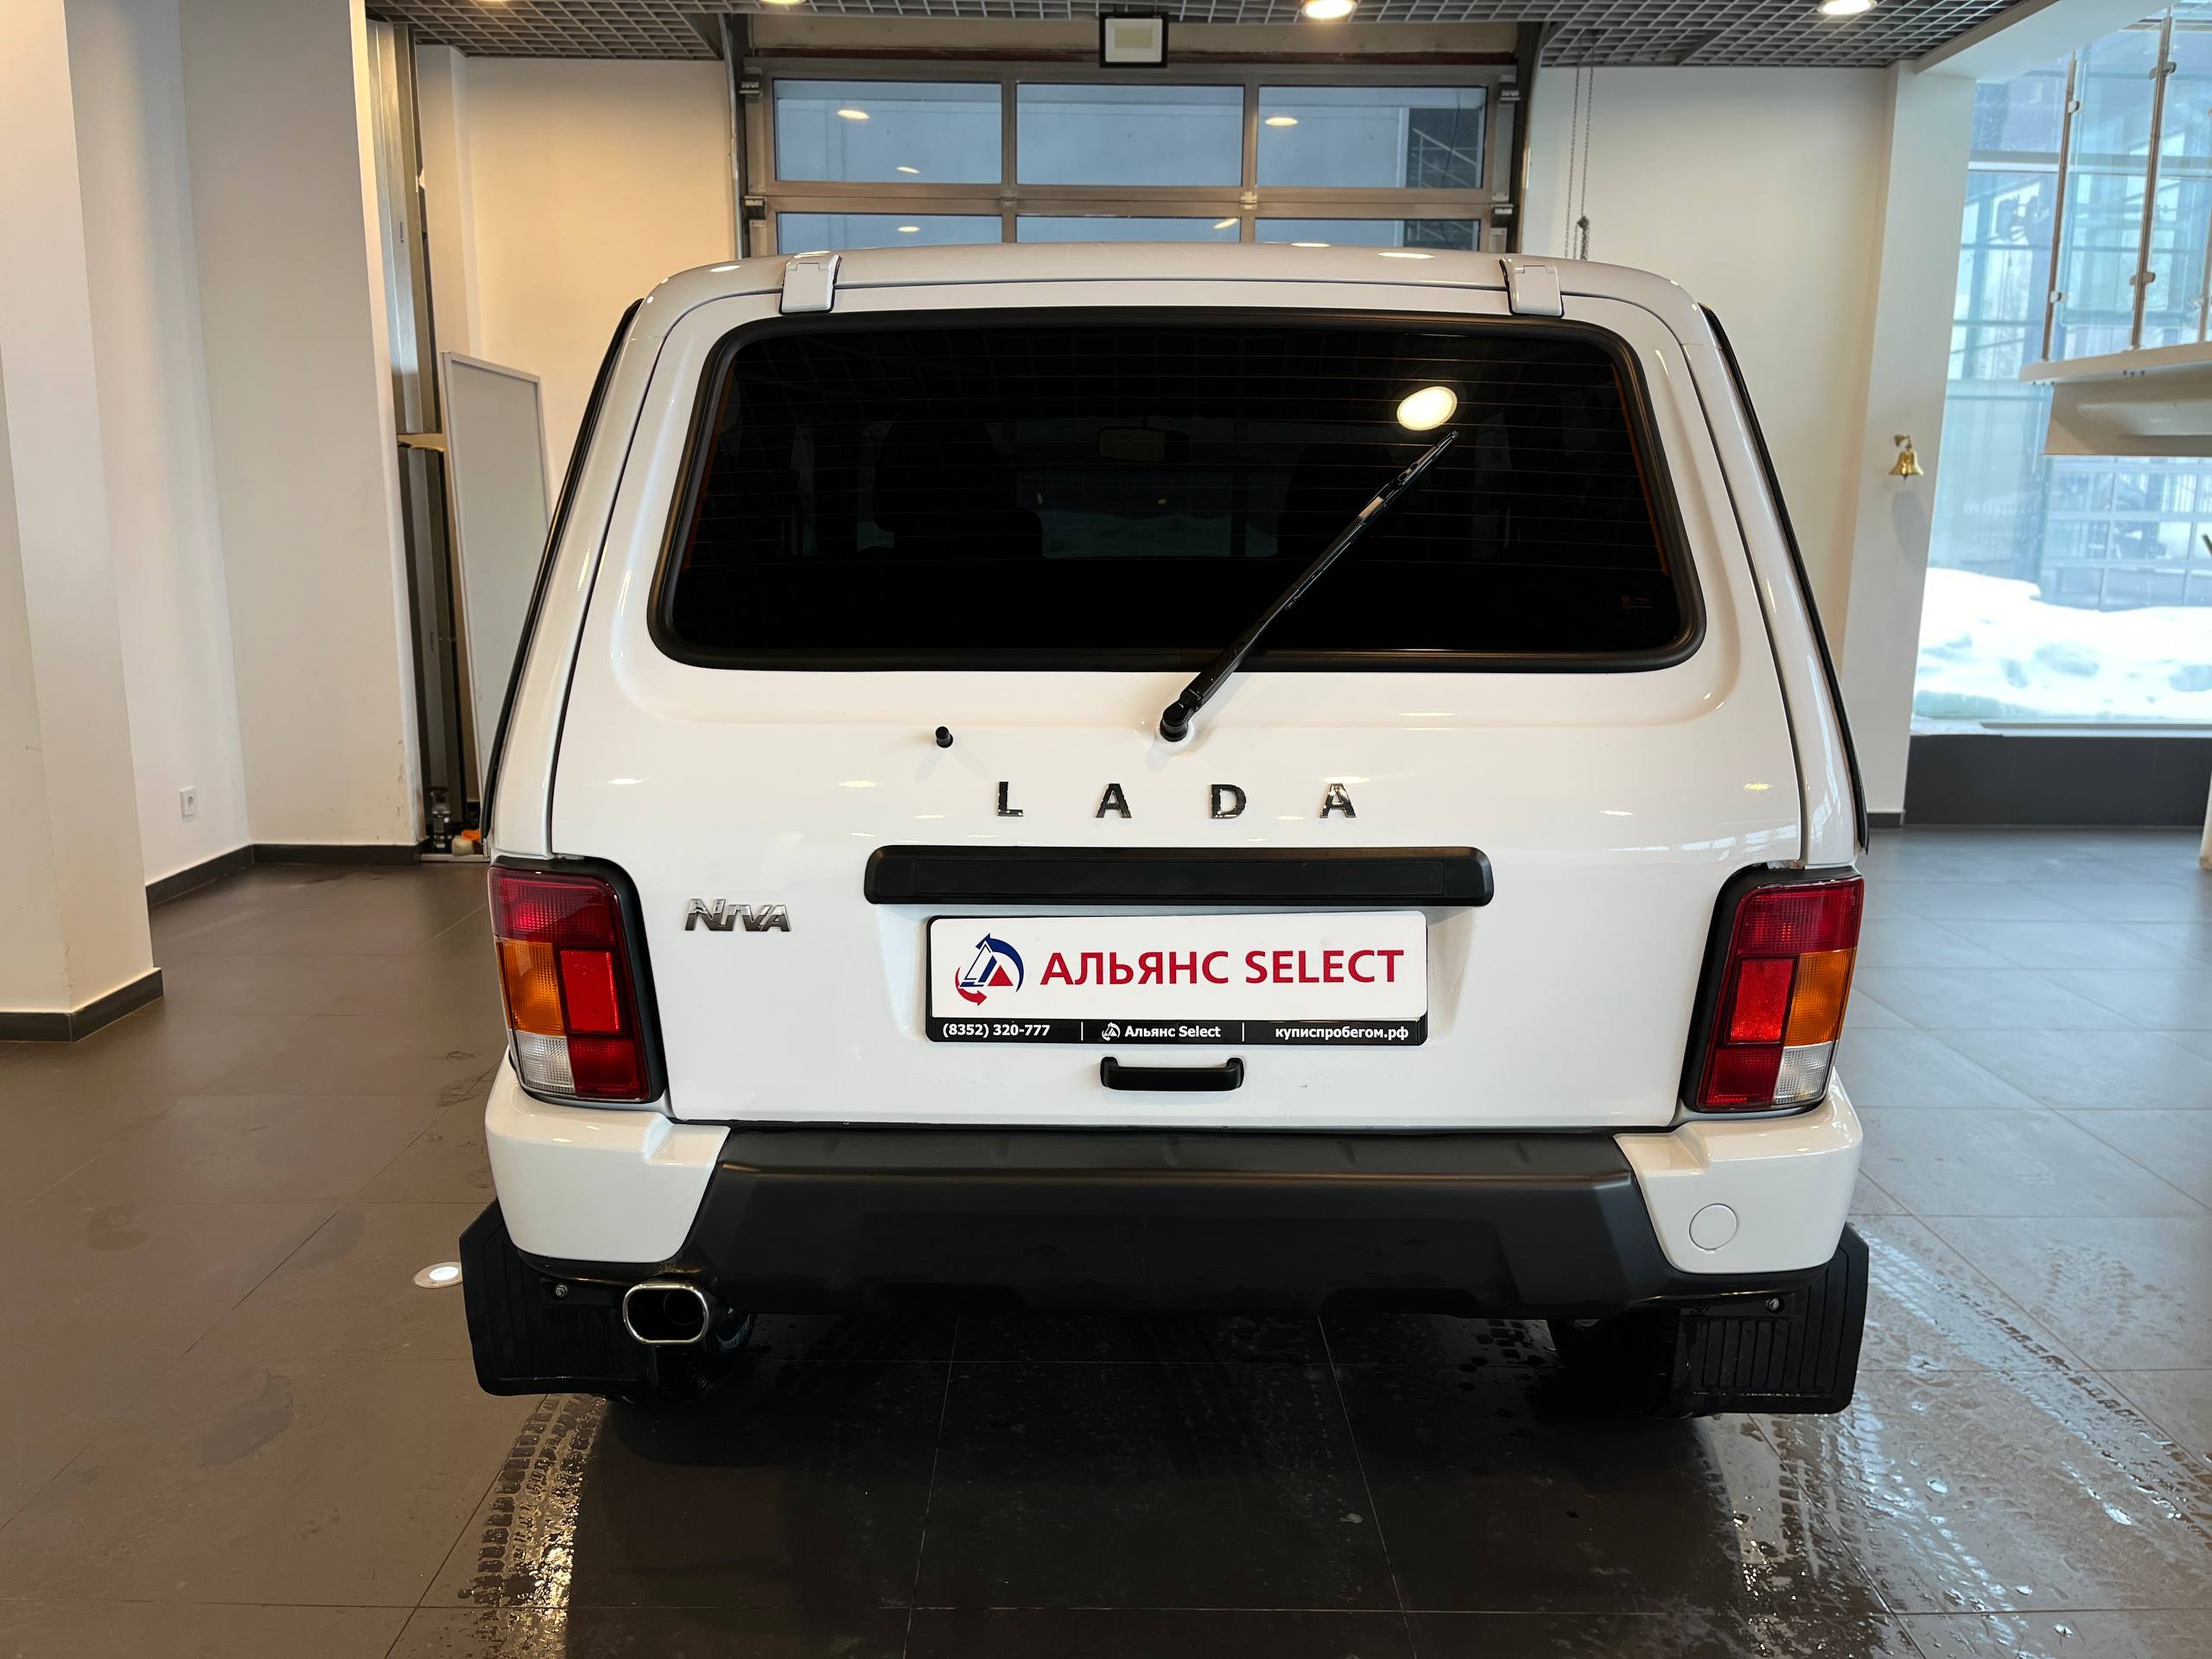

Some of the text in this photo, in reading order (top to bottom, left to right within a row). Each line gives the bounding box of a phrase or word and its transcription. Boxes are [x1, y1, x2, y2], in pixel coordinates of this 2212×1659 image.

[997, 781, 1357, 819] LADA
[684, 898, 791, 932] NIVA
[1039, 950, 1405, 986] АЛЬЯНС SELECT
[942, 1023, 1051, 1039] (8352) 320-777
[1124, 1025, 1222, 1038] Альянс Select
[1274, 1026, 1409, 1041] куписпробегом.рф
